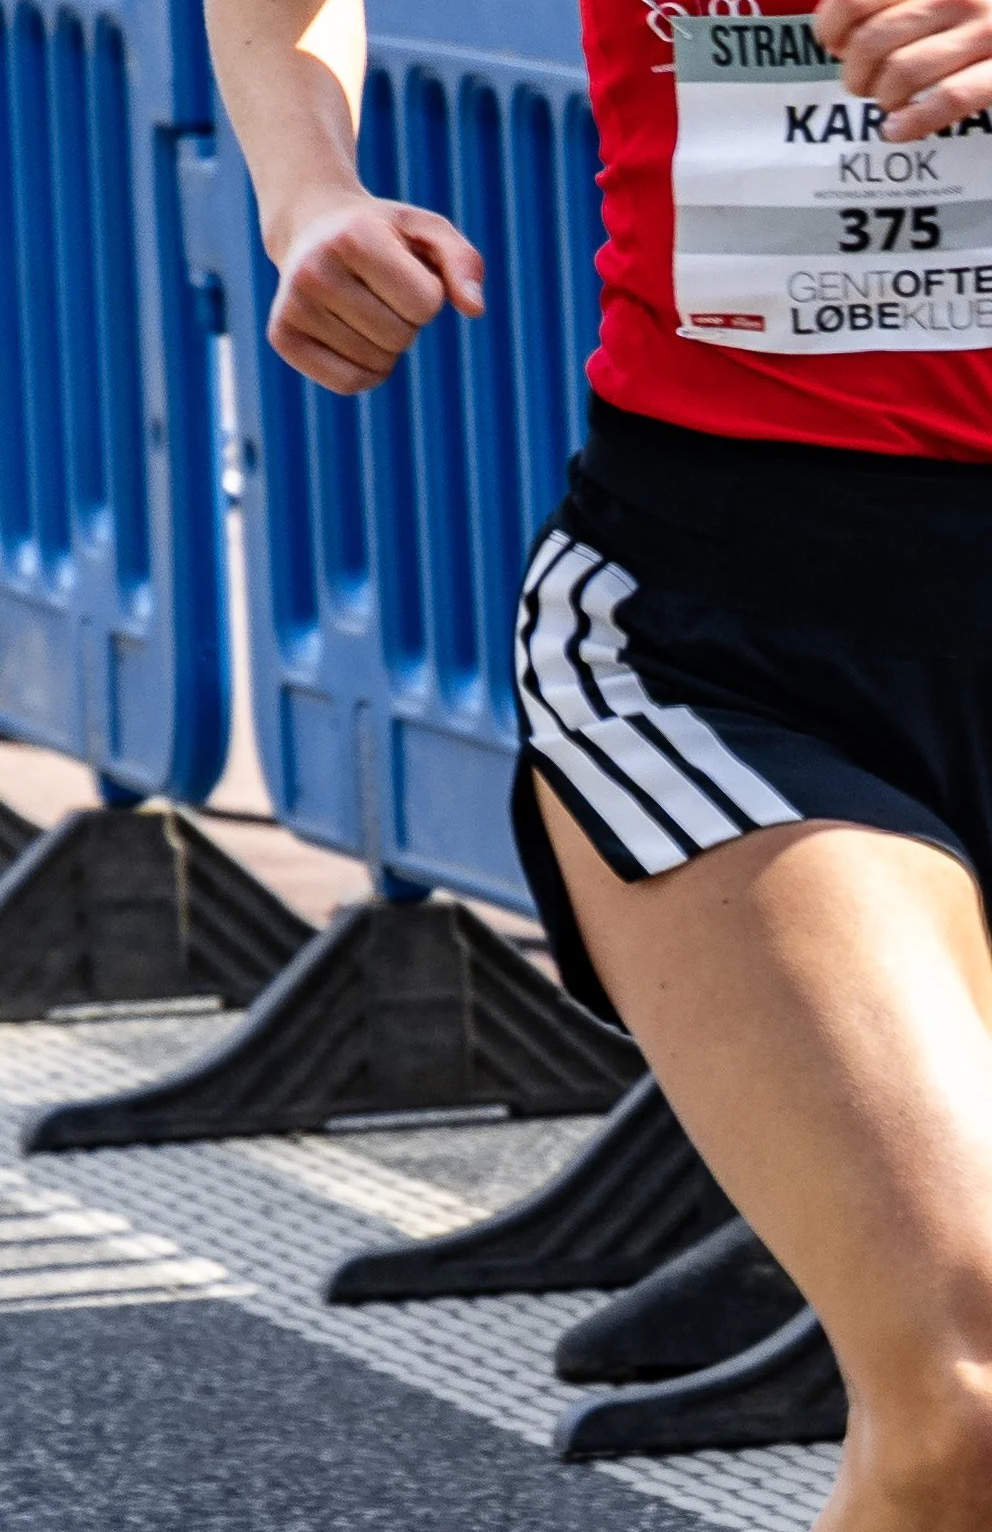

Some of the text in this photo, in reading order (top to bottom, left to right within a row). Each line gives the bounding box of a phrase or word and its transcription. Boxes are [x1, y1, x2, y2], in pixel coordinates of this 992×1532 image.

[711, 23, 843, 67] STRAN
[838, 149, 939, 183] KLOK
[838, 206, 942, 253] 375
